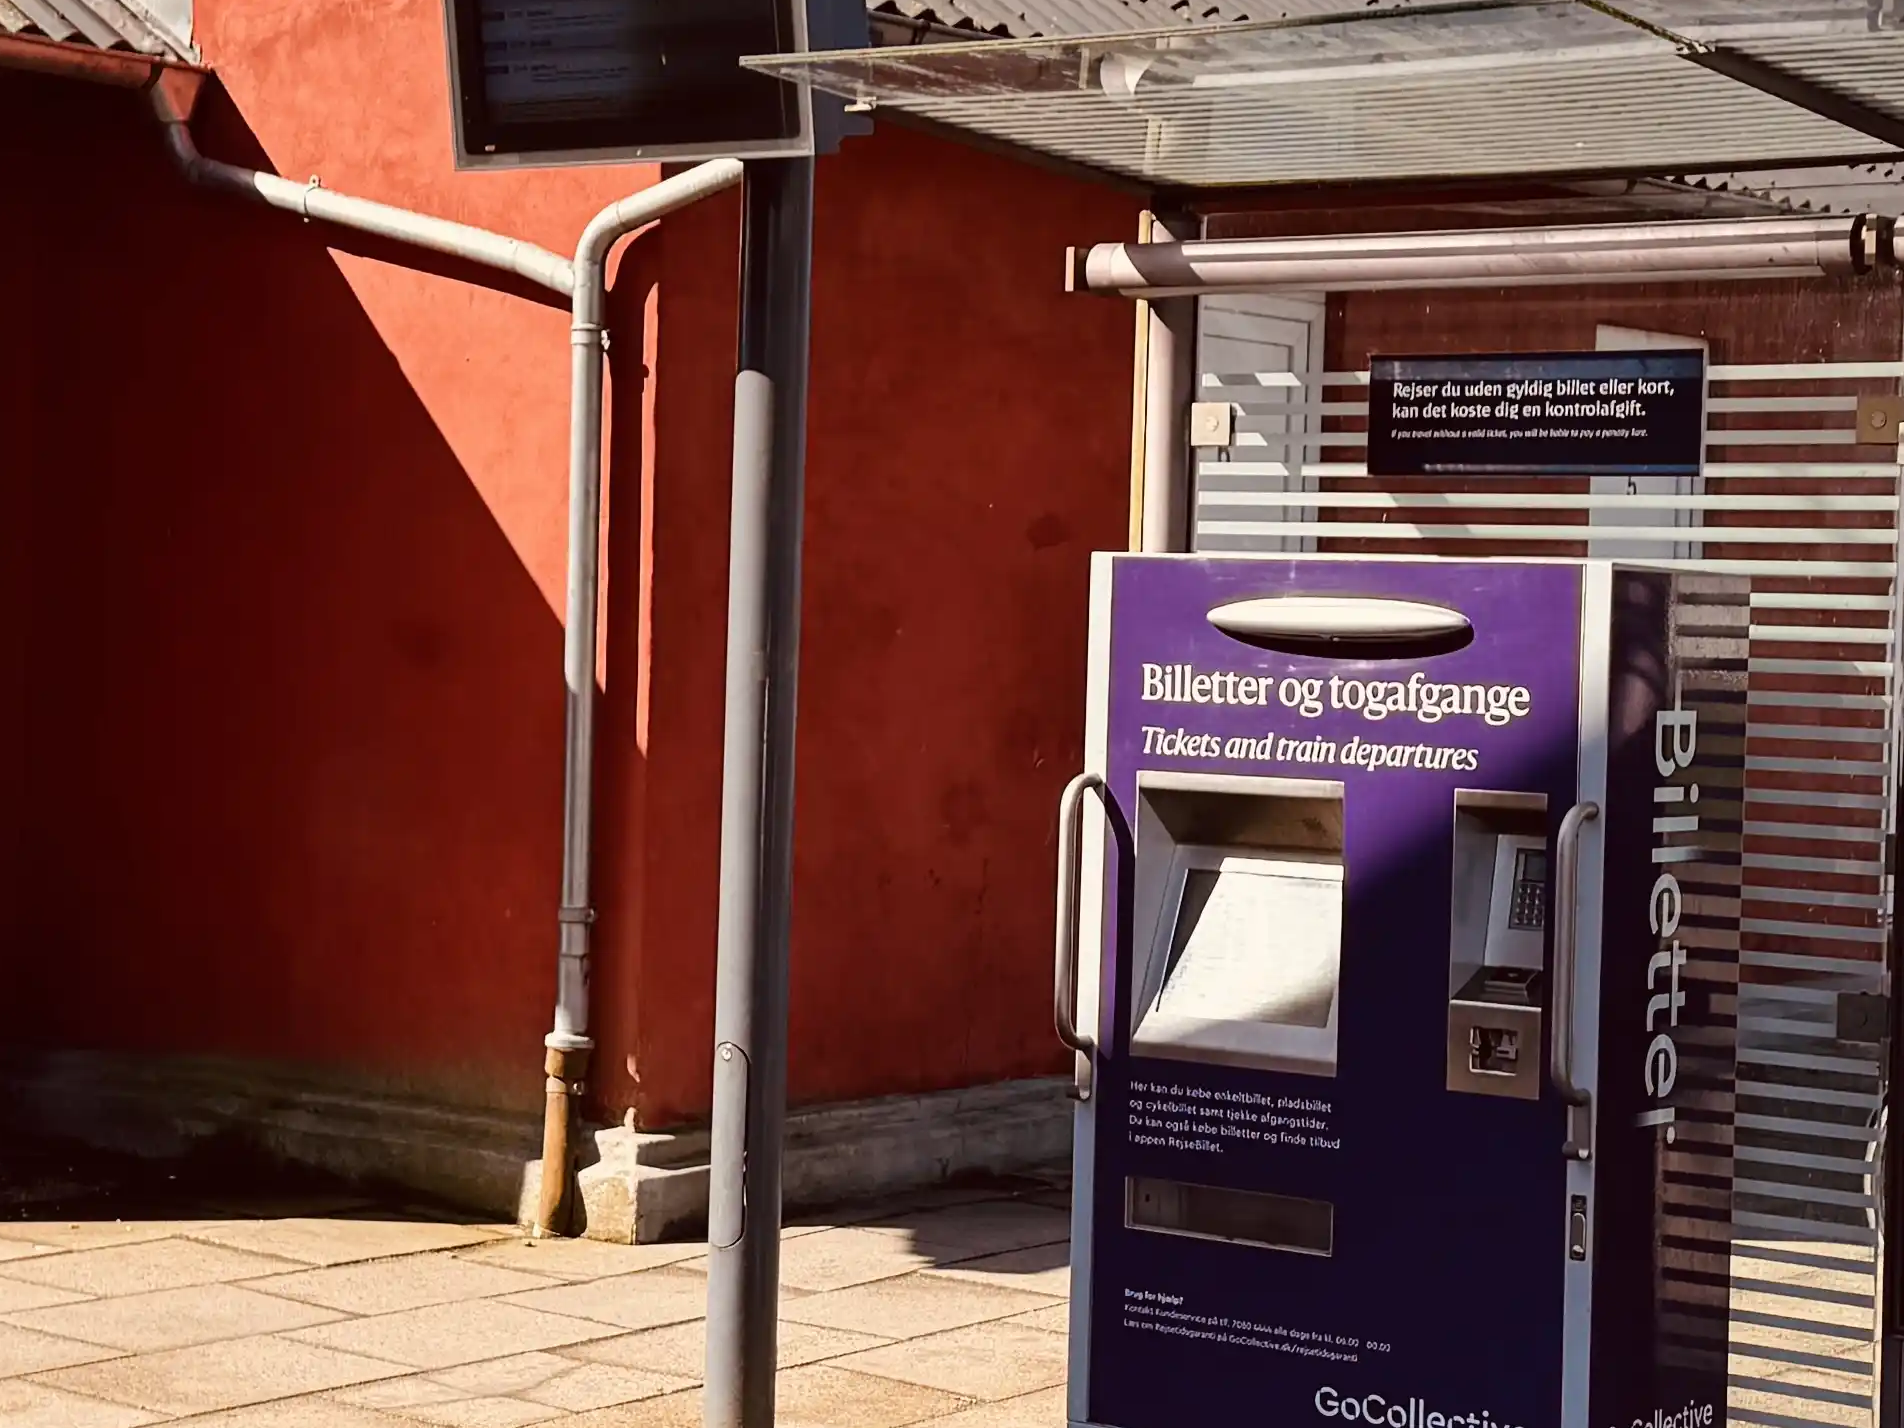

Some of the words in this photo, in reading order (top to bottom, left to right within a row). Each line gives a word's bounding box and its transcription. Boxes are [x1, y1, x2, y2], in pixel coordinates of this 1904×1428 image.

[1393, 381, 1438, 401] Rejser
[1441, 380, 1461, 397] du
[1464, 380, 1502, 397] uden
[1506, 379, 1553, 400] gyldig
[1556, 379, 1596, 396] billet
[1599, 378, 1634, 396] eller
[1637, 378, 1674, 397] kort,
[1392, 402, 1419, 418] kan
[1422, 402, 1447, 418] det
[1450, 402, 1491, 418] koste
[1494, 401, 1519, 420] dig
[1522, 404, 1541, 418] en
[1545, 400, 1646, 419] kontrolafgift.
[1141, 663, 1274, 707] Billetter
[1279, 677, 1324, 718] og
[1328, 671, 1531, 727] togafgange
[1141, 725, 1221, 759] Tickets
[1224, 732, 1275, 762] and
[1279, 735, 1336, 765] train
[1340, 735, 1480, 772] departures
[1635, 709, 1700, 1146] Billetter
[1130, 1080, 1148, 1092] Her
[1150, 1082, 1168, 1094] kan
[1170, 1084, 1184, 1096] du
[1129, 1099, 1143, 1111] og
[1199, 1107, 1224, 1118] samt
[1227, 1108, 1258, 1122] tjekke
[1129, 1114, 1143, 1125] Du
[1145, 1115, 1163, 1128] kan
[1220, 1124, 1260, 1140] billetter
[1263, 1132, 1277, 1144] og
[1280, 1131, 1307, 1145] finde
[1309, 1136, 1341, 1149] tilbud
[1134, 1134, 1166, 1146] appen
